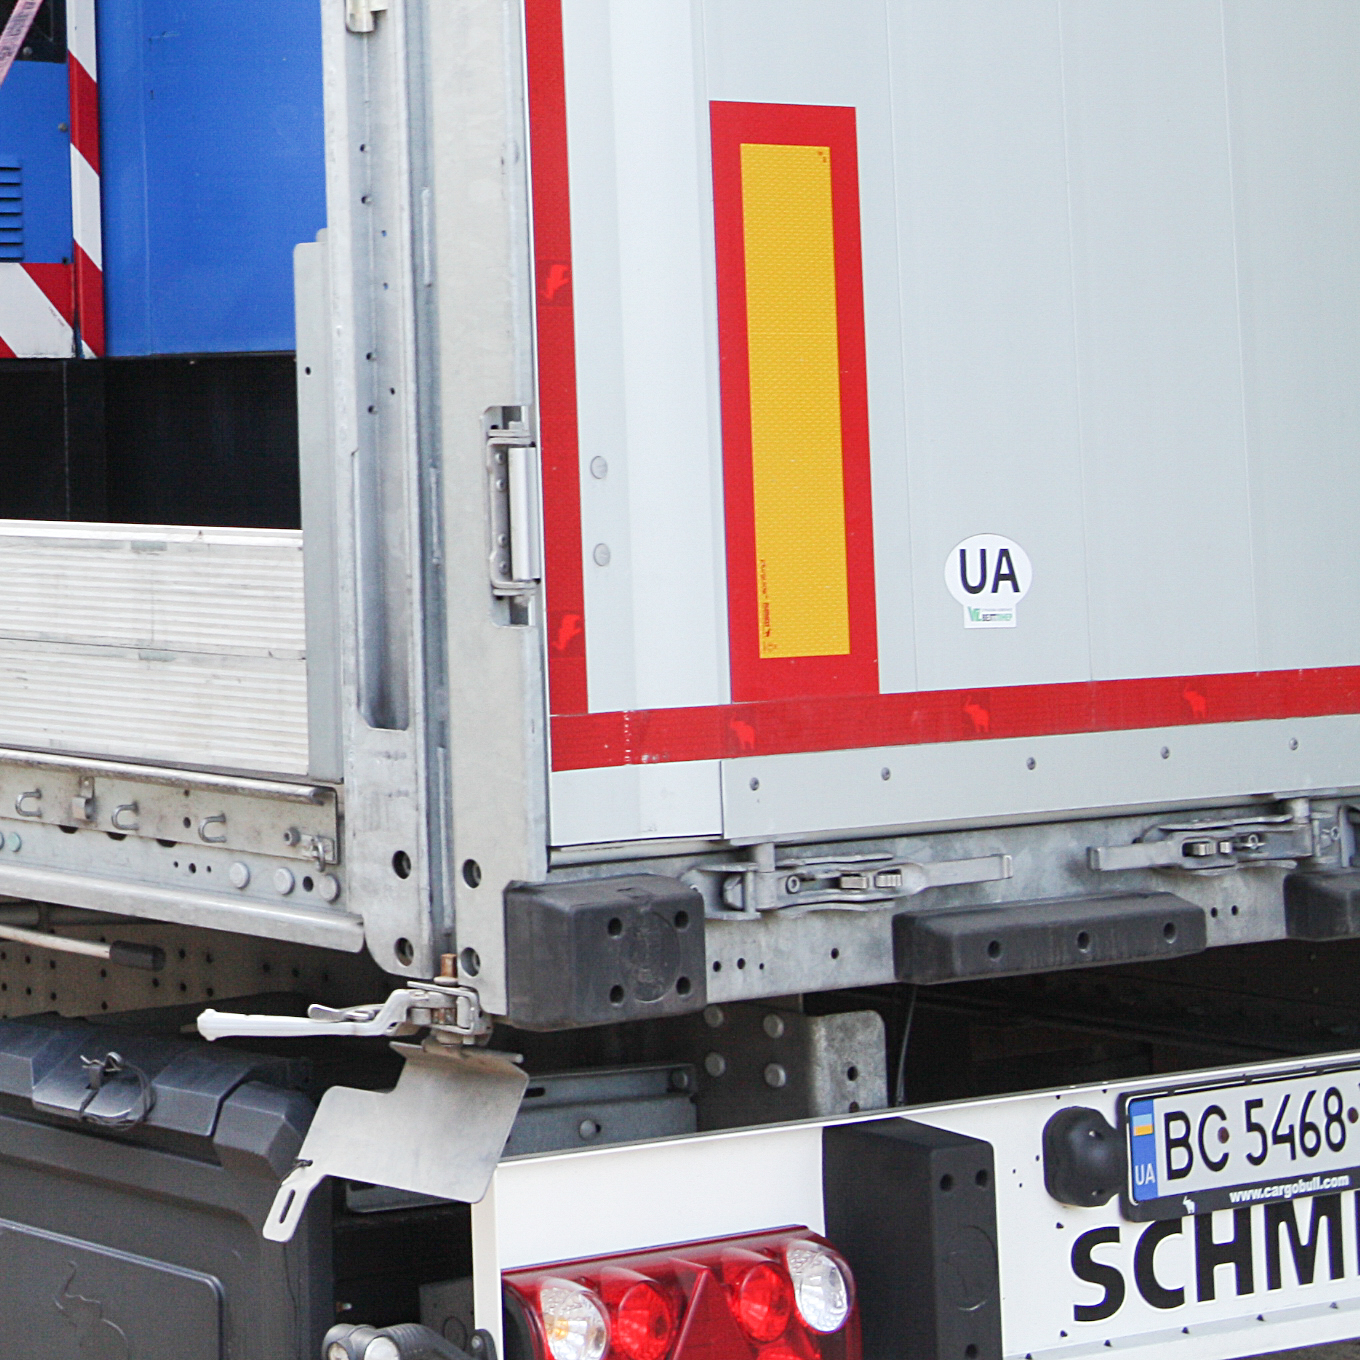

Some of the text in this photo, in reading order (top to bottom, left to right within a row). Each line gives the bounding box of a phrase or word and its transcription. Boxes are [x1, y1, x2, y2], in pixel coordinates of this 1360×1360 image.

[959, 548, 1021, 595] UA
[1163, 1086, 1347, 1181] BC 5468
[1135, 1163, 1156, 1186] UA
[1229, 1174, 1350, 1203] www.cargobull.com
[1070, 1189, 1360, 1323] SCHM
